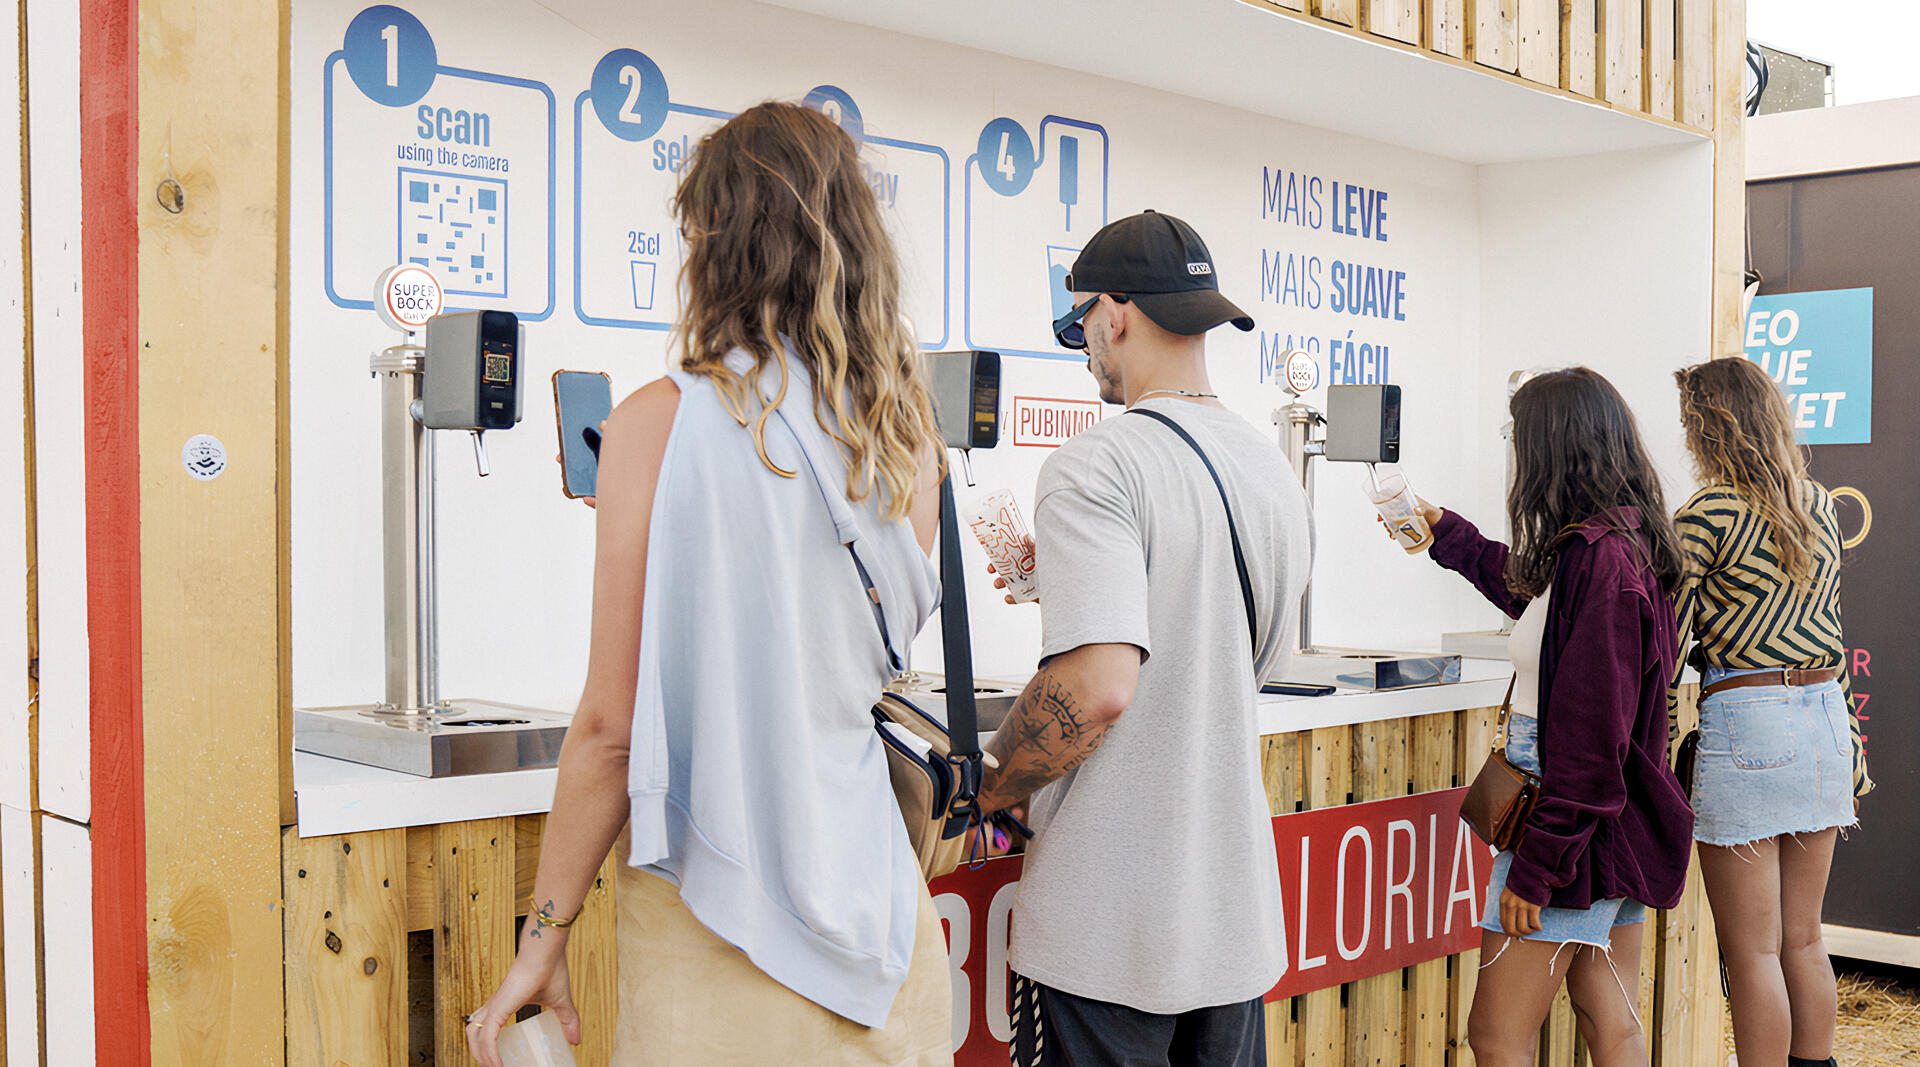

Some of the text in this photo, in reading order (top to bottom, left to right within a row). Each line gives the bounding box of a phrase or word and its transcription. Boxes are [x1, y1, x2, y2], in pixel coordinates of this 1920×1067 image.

[381, 24, 399, 88] 1
[618, 64, 642, 125] 2
[417, 104, 491, 147] scan
[397, 143, 509, 173] using the camera
[996, 131, 1016, 181] 4
[1262, 165, 1388, 242] MAIS LEVE
[628, 230, 660, 256] 25cl
[394, 283, 435, 297] SUPER
[397, 297, 433, 310] BOCK
[1261, 248, 1406, 321] MAIS SUAVE
[1260, 331, 1320, 390] MS
[1298, 813, 1500, 971] LORIA
